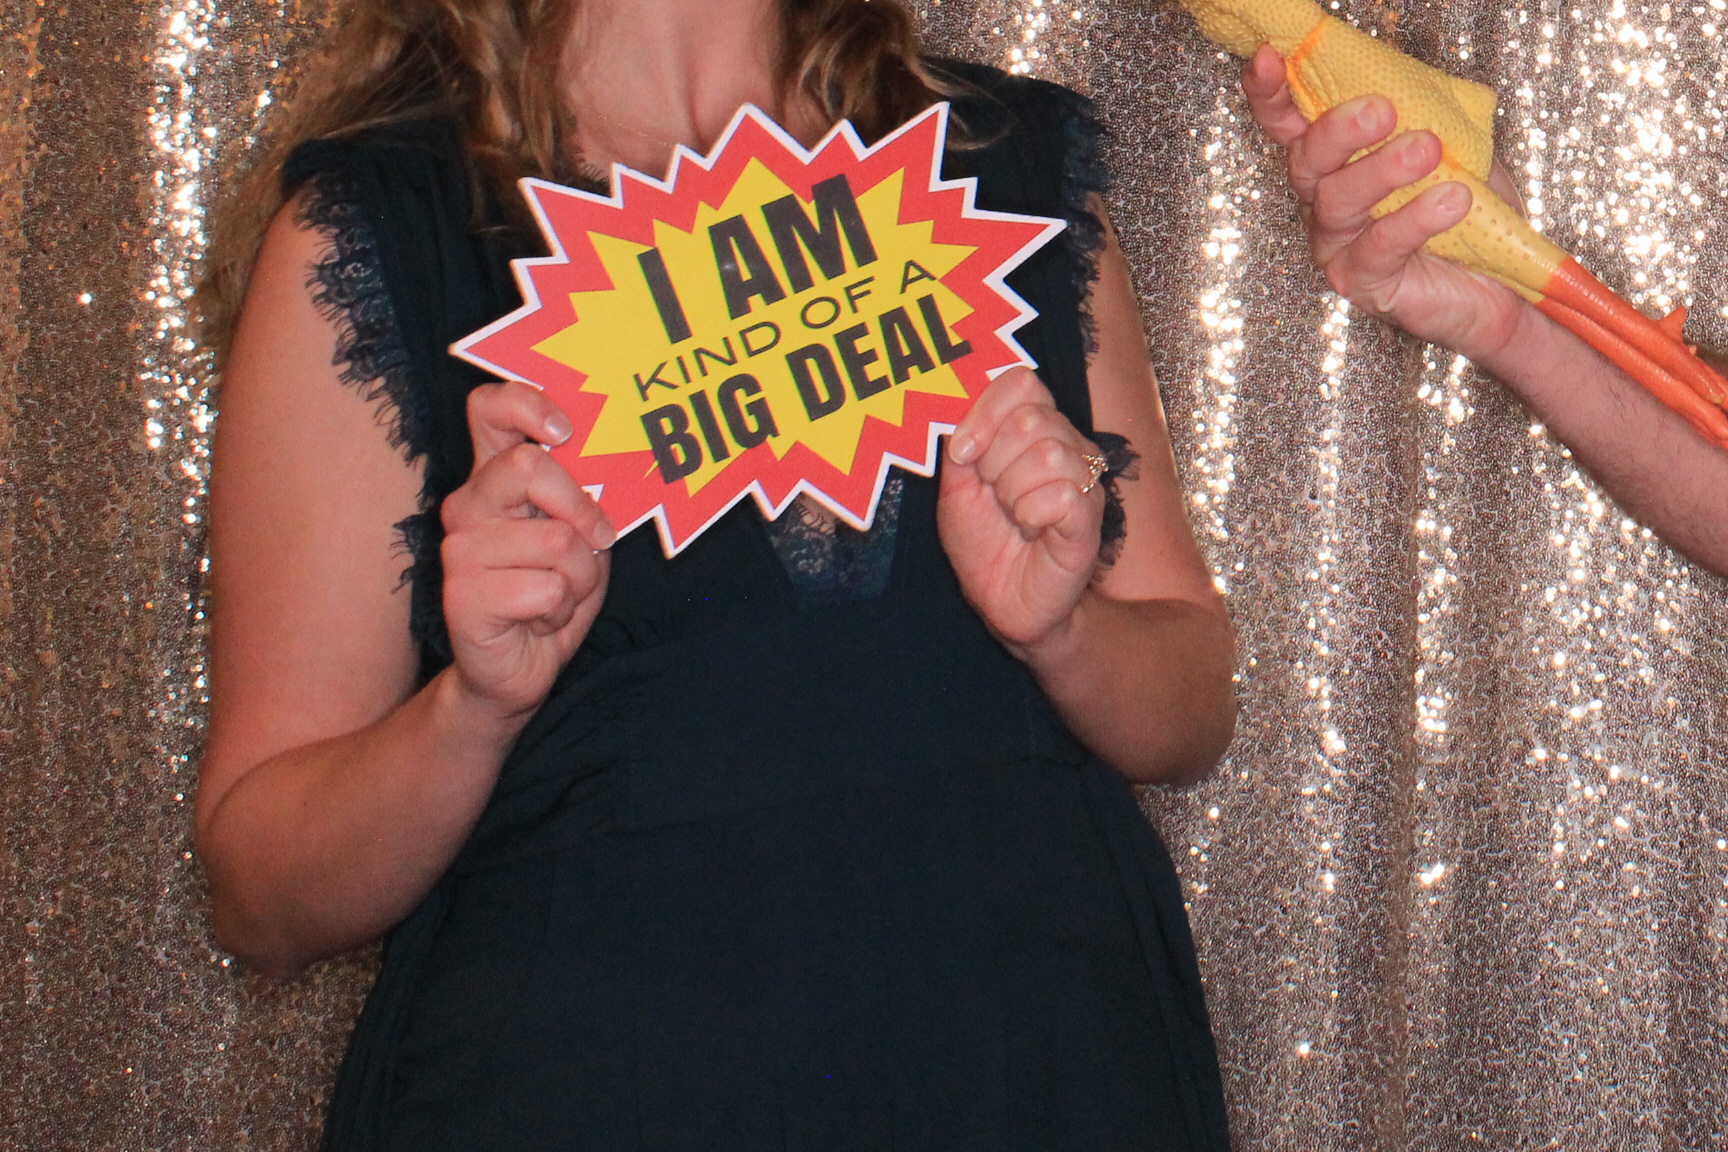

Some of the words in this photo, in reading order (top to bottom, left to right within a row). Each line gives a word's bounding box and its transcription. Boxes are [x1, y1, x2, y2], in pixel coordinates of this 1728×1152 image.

[633, 321, 782, 402] KIND
[800, 277, 876, 329] OF
[899, 260, 937, 294] A
[637, 248, 692, 345] I
[708, 173, 878, 320] AM
[640, 373, 780, 485] BIG
[785, 294, 974, 422] DEAL
